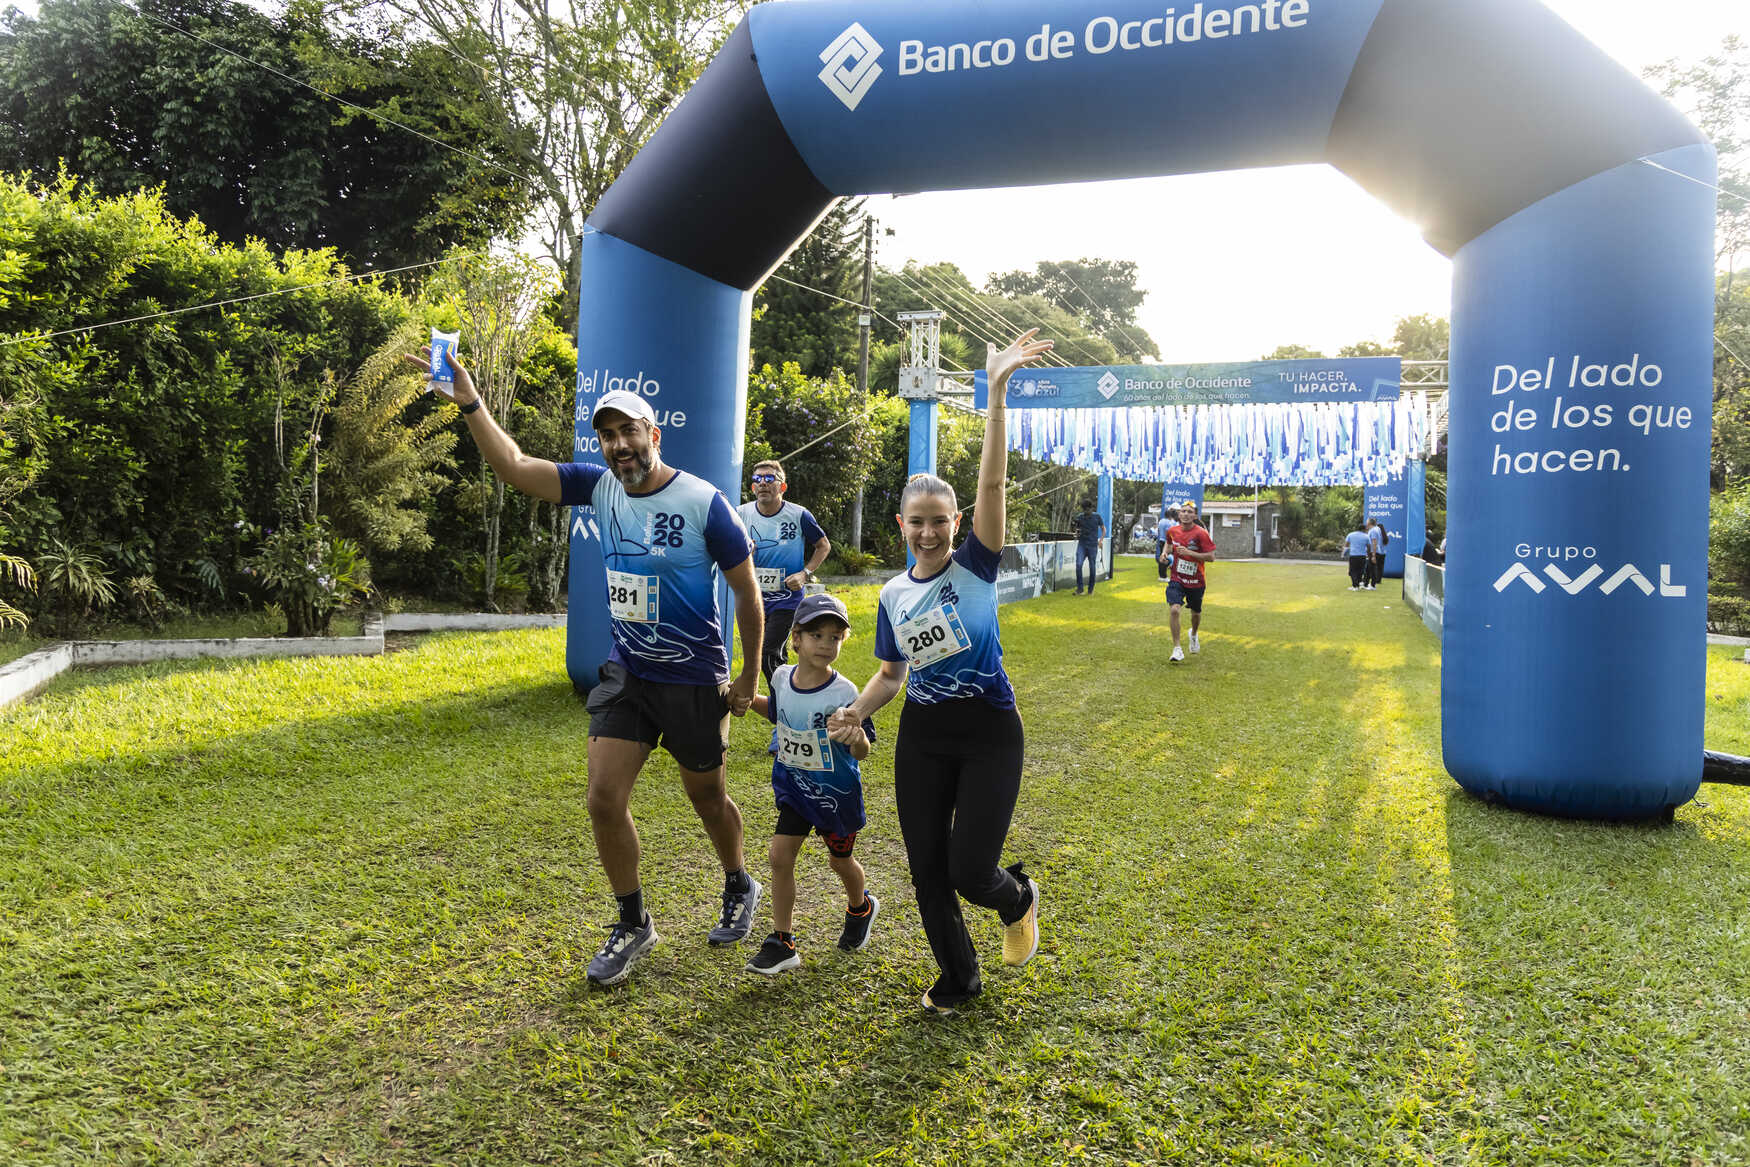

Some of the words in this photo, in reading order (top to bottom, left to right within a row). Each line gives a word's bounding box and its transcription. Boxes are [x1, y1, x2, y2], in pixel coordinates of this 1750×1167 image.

[898, 38, 1015, 76] Banco
[1025, 24, 1075, 62] de
[1085, 0, 1309, 55] Occidente
[577, 369, 598, 392] Del
[602, 369, 660, 396] lado
[1125, 379, 1163, 390] Banco
[1167, 377, 1182, 389] de
[1185, 376, 1251, 388] Occidente
[1279, 372, 1295, 382] TU
[1492, 356, 1554, 395] Del
[1569, 353, 1663, 388] lado
[1293, 382, 1362, 393] IMPACTA.
[575, 398, 590, 421] de
[655, 410, 687, 427] ue
[1491, 400, 1536, 432] de
[1552, 397, 1613, 428] los
[1628, 404, 1692, 435] que
[1492, 444, 1631, 475] hacen.
[654, 512, 685, 530] 20
[780, 522, 797, 530] 20
[653, 530, 684, 548] 26
[780, 531, 796, 540] 26
[650, 546, 666, 557] 5K
[1515, 543, 1597, 560] Grupo
[758, 575, 777, 584] 127
[1493, 562, 1686, 597] AVAL
[610, 585, 638, 605] 281
[908, 625, 945, 653] 280
[783, 737, 813, 757] 279
